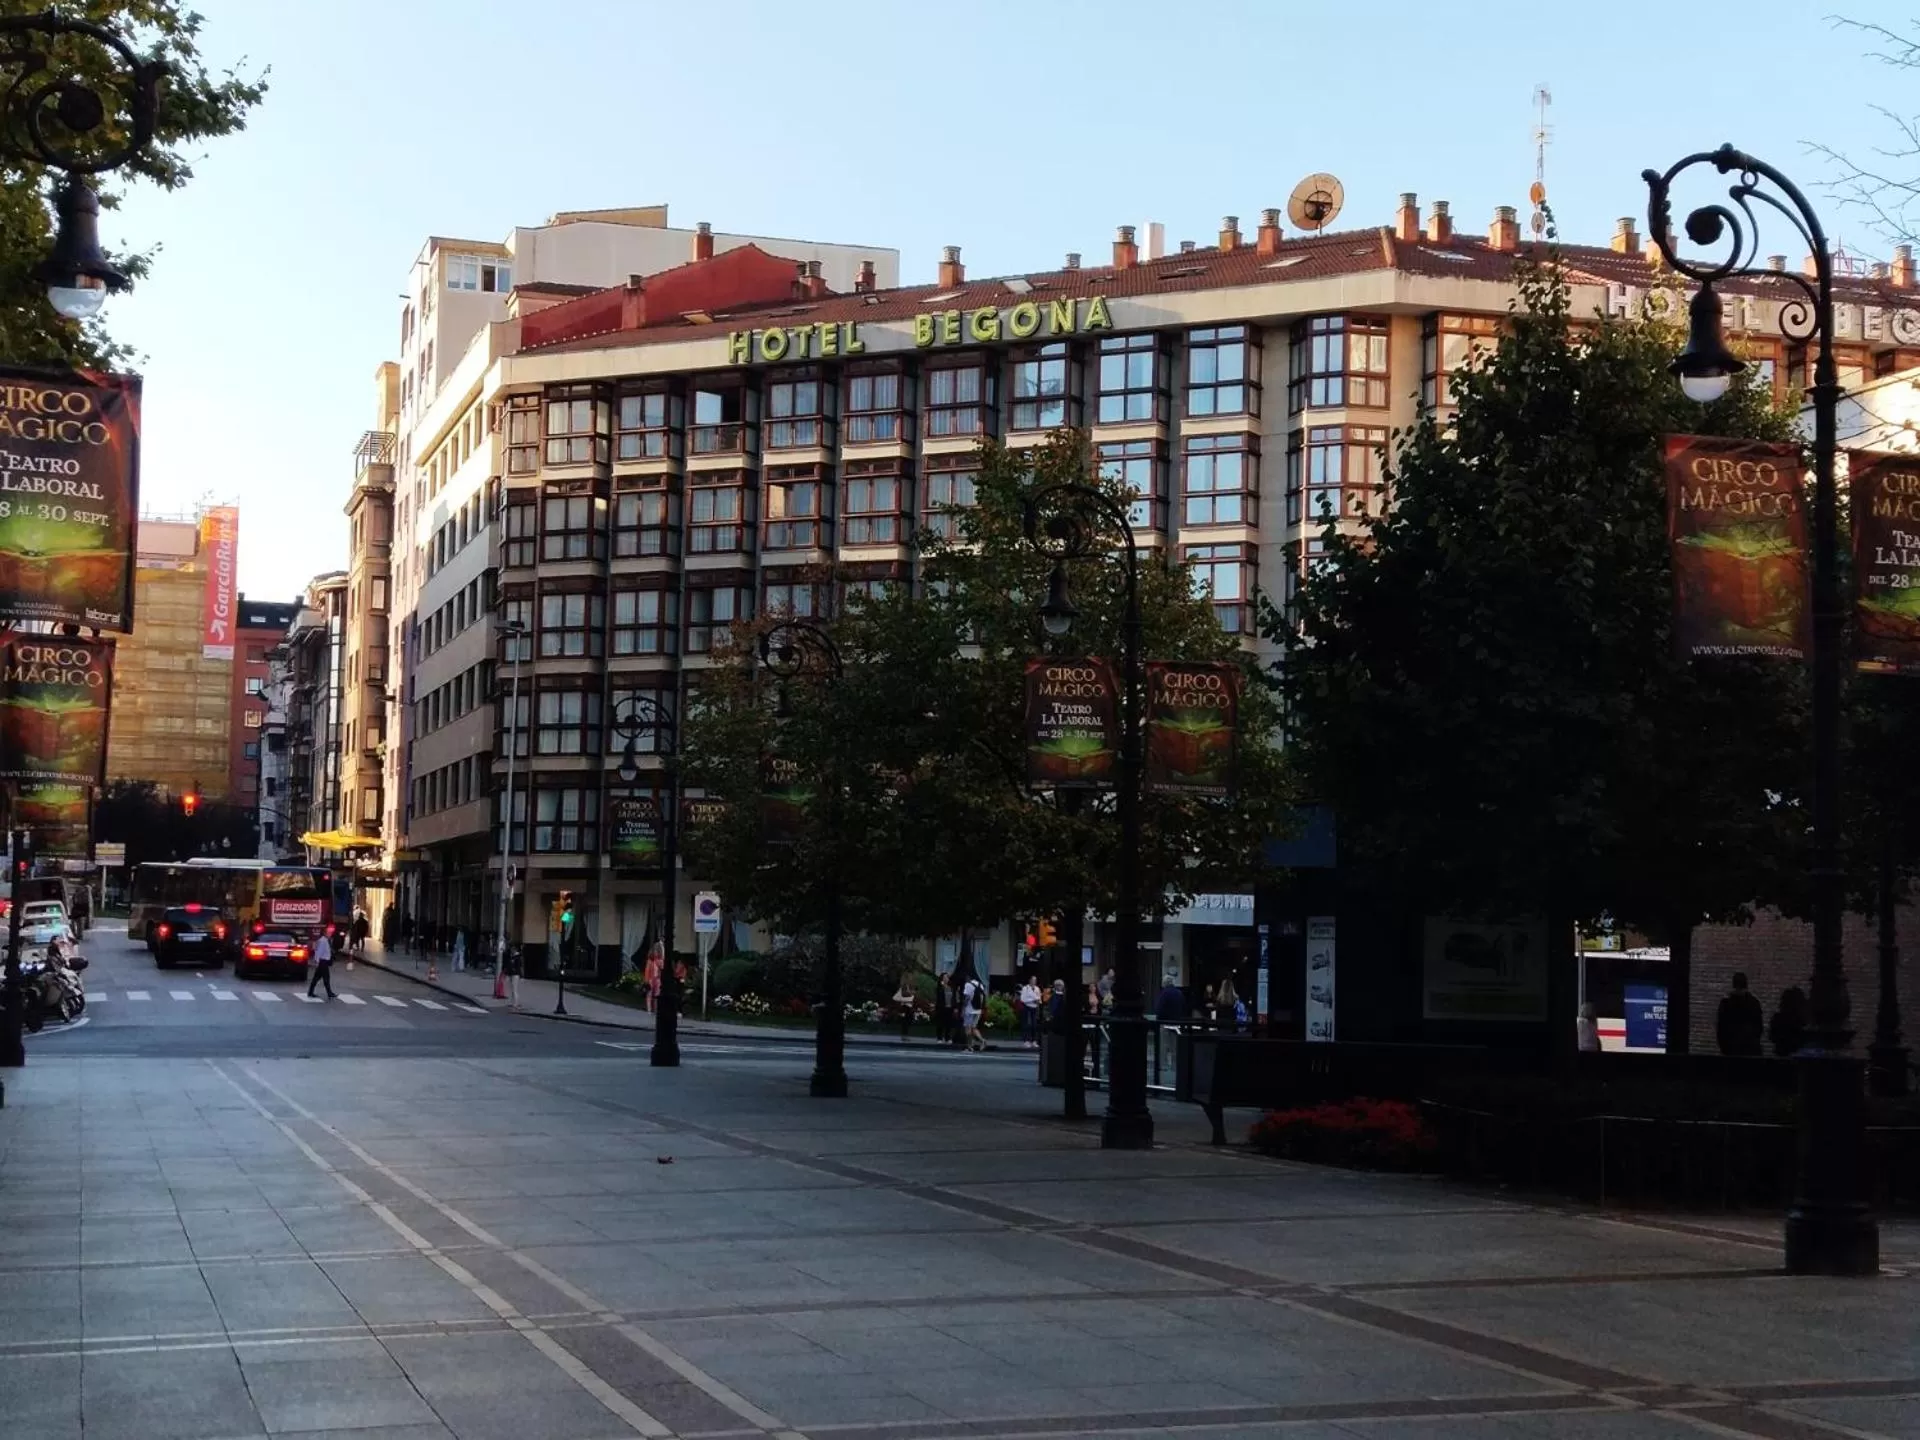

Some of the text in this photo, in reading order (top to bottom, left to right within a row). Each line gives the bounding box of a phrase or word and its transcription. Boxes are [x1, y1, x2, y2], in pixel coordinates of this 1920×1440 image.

[1609, 282, 1761, 333] HOEL
[728, 320, 865, 364] HOTEL
[0, 386, 92, 416] IRCO
[1691, 457, 1779, 487] CIRCO
[2, 471, 104, 500] LABORAL
[16, 505, 33, 516] AL
[38, 504, 67, 522] 30
[73, 510, 109, 527] SEPT.
[1874, 547, 1897, 565] LA
[1891, 573, 1910, 588] 28
[18, 646, 92, 667] CIRCO
[1046, 667, 1097, 683] CIRCO
[1164, 672, 1221, 691] CIRCO
[1051, 702, 1092, 714] TEATRO
[1041, 714, 1103, 726] LA LABORAL
[1051, 730, 1063, 739] 28
